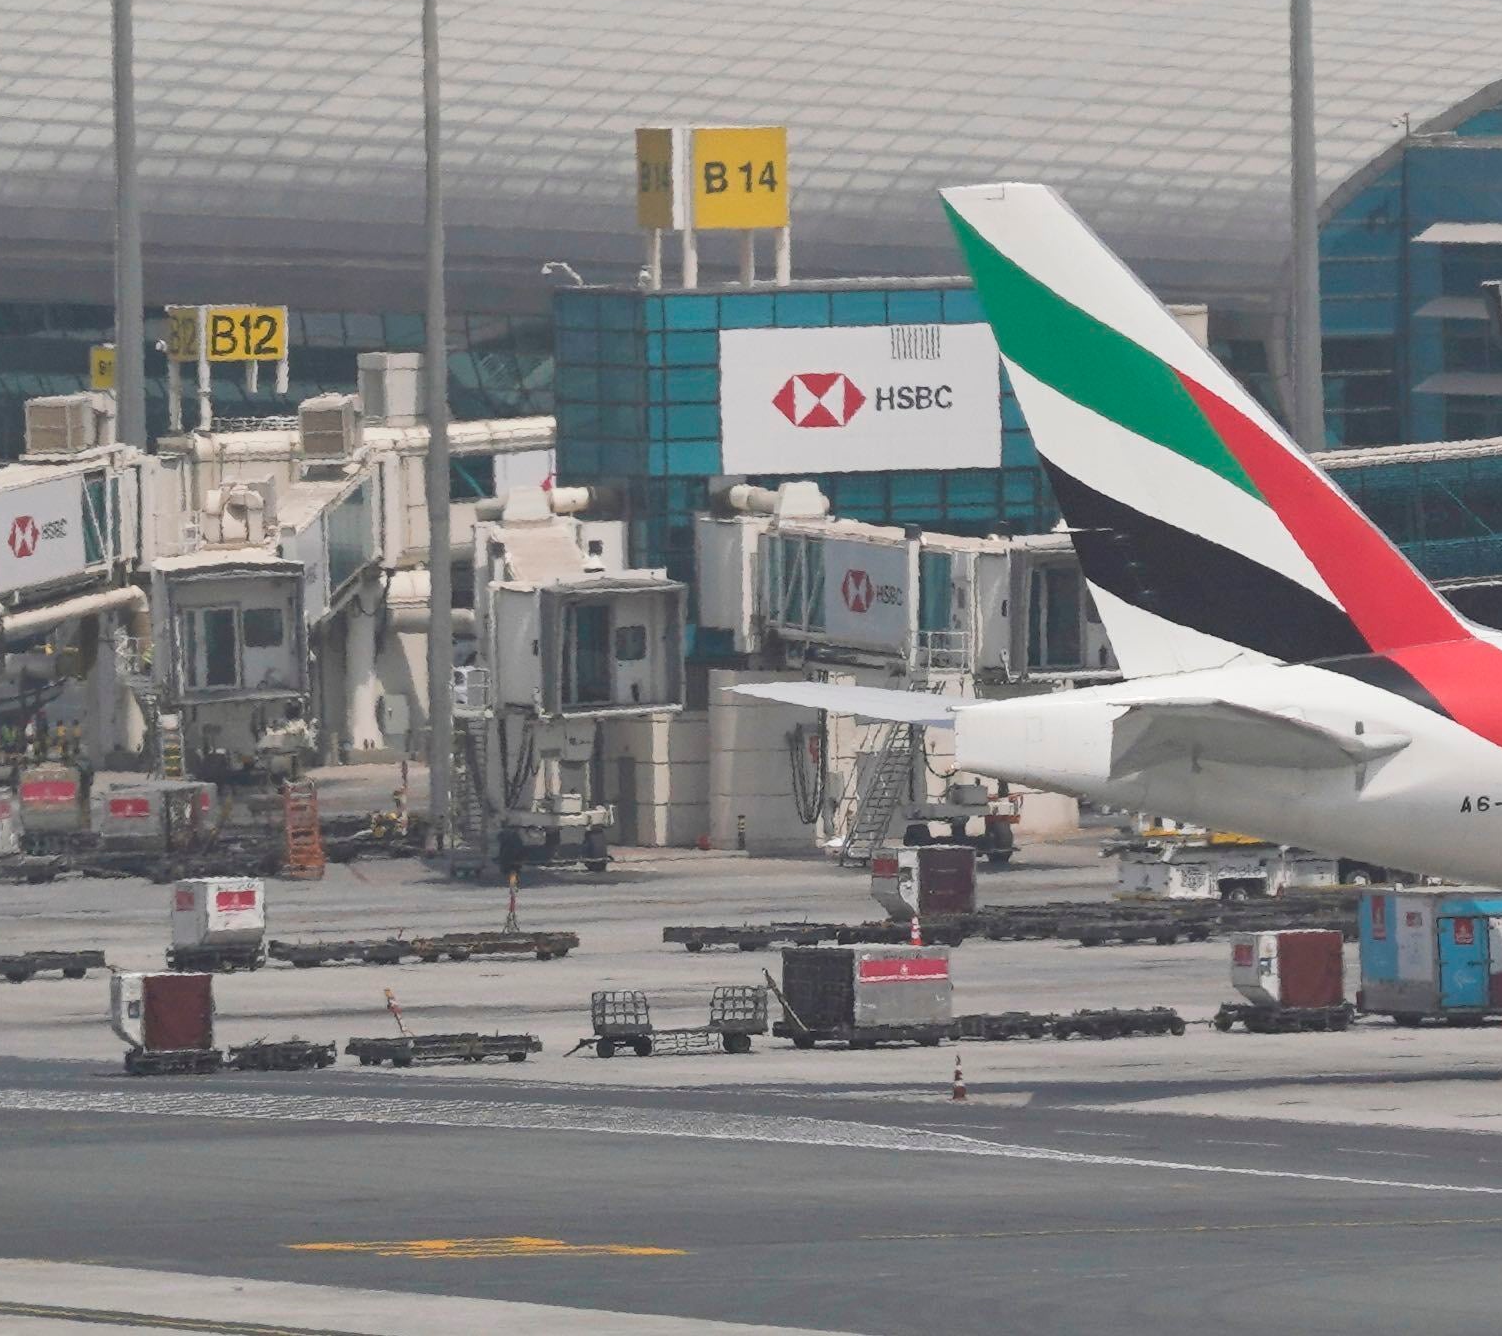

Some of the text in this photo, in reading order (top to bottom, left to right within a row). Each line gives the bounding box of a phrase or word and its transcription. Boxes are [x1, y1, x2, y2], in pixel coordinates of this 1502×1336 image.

[704, 160, 778, 194] B 14
[211, 314, 279, 356] B12
[876, 384, 953, 411] HSBC
